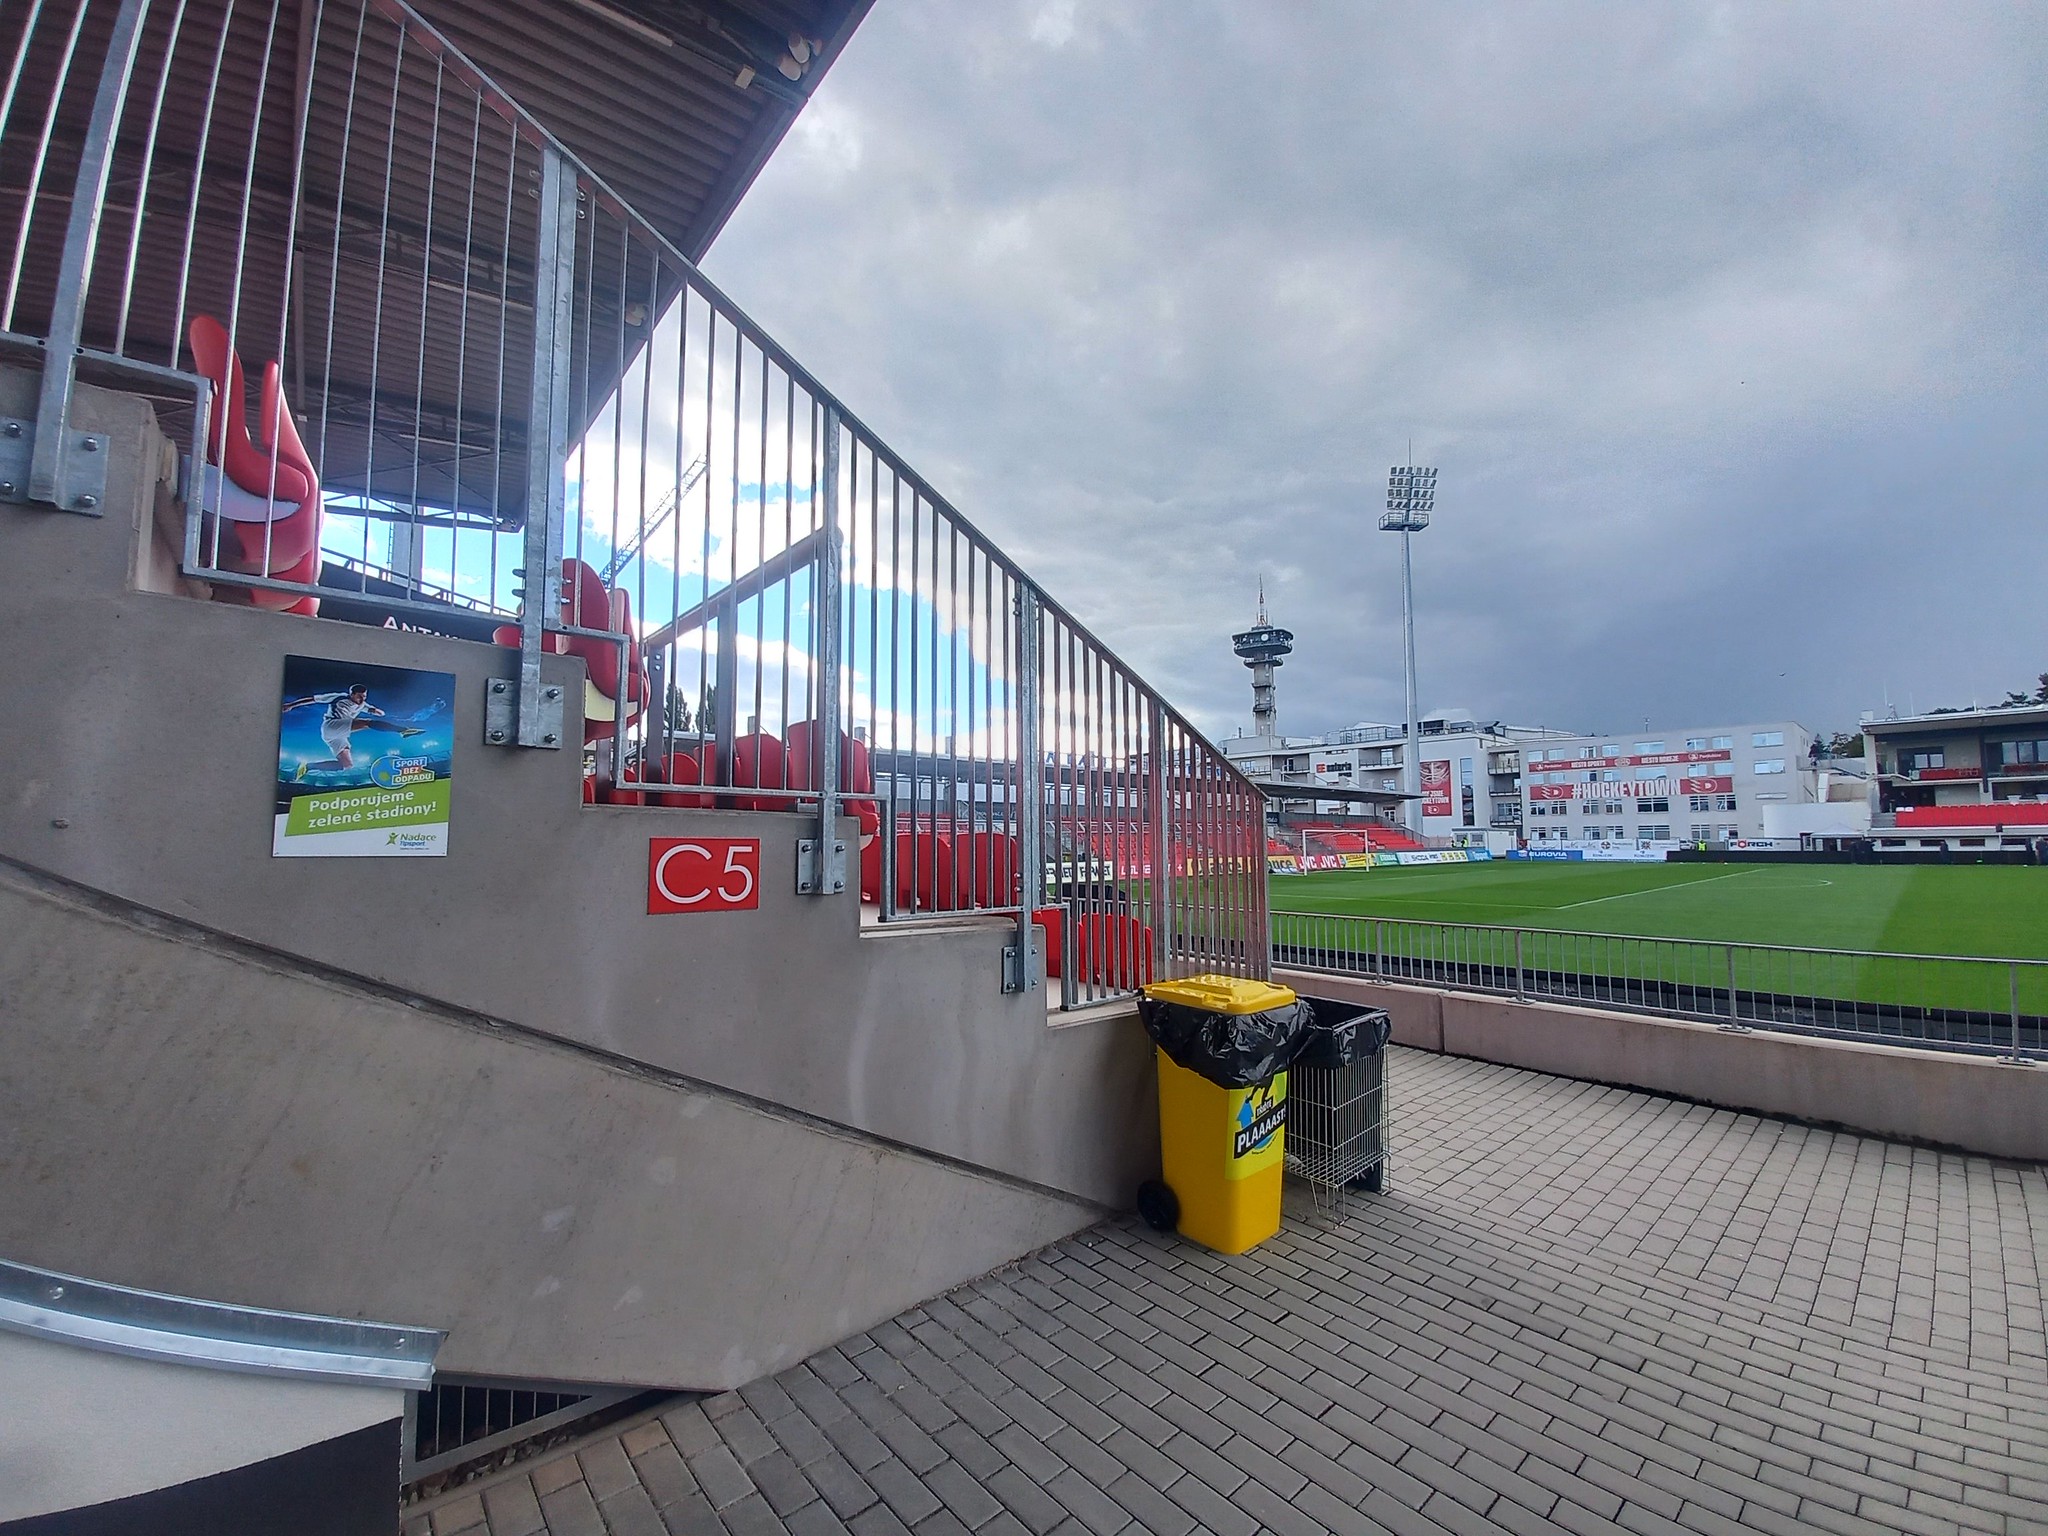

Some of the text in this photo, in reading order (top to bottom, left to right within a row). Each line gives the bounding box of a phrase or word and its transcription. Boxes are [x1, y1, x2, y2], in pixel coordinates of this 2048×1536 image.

[396, 759, 425, 768] SPORT
[403, 766, 420, 775] BEZ
[395, 773, 432, 783] ODPADU
[1571, 777, 1682, 800] #HOCKEYTOWN
[309, 791, 415, 813] Podporujeme
[308, 801, 437, 829] zelené stadiony!
[400, 832, 437, 842] Nadace
[1320, 855, 1337, 868] JVC
[656, 844, 753, 904] C5
